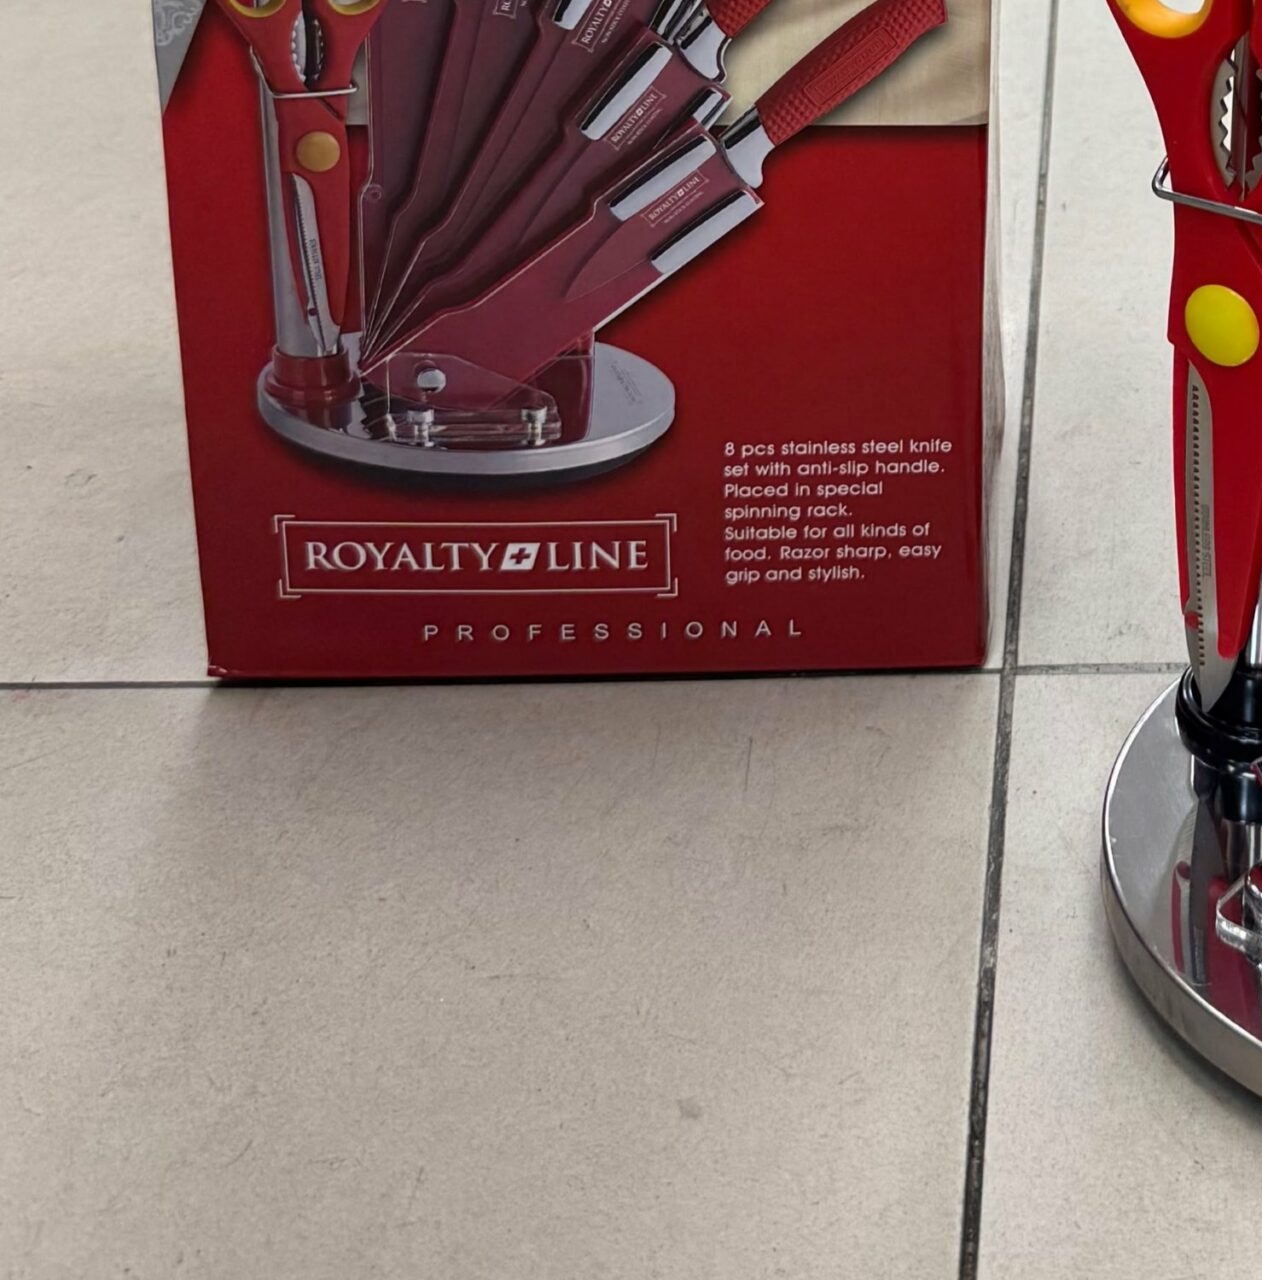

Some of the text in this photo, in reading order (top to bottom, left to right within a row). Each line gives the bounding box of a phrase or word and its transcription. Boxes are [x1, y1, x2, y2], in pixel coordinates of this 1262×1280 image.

[580, 2, 609, 44] ROYALTY
[611, 111, 639, 143] ROYALTY
[648, 191, 680, 220] ROYALTY
[724, 438, 953, 459] 8 pcs stainless steel knife
[724, 459, 945, 478] set with anti-slip handle.
[724, 480, 884, 499] Placed in special
[724, 502, 853, 521] spinning rack.
[724, 521, 931, 541] Suitable for all kinds of
[304, 539, 649, 572] ROYALTY LINE
[724, 543, 942, 562] food. Razor sharp, easy
[725, 564, 865, 586] grip and stylish.
[422, 618, 804, 643] PROFESSIONAL
